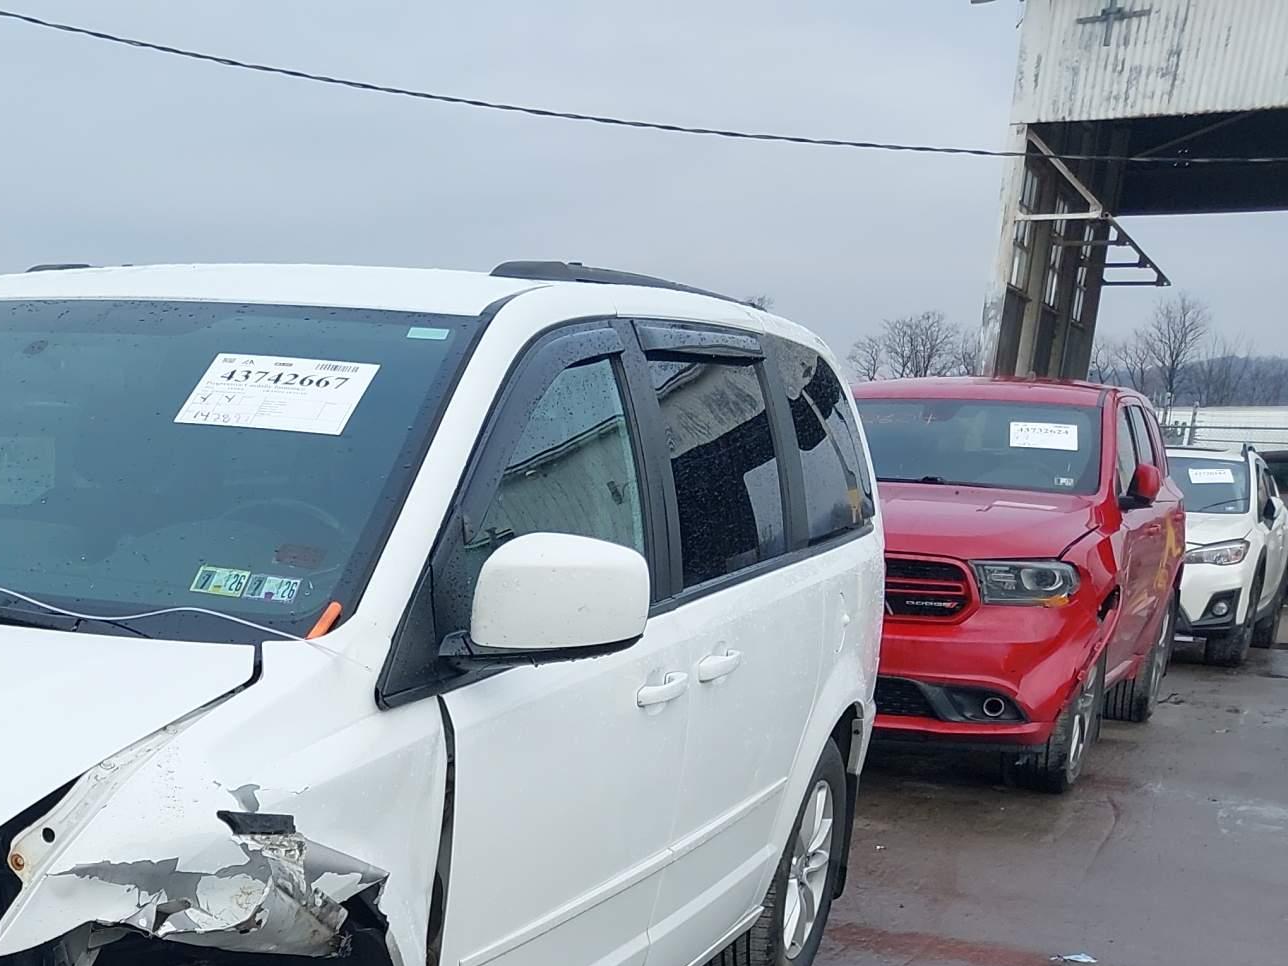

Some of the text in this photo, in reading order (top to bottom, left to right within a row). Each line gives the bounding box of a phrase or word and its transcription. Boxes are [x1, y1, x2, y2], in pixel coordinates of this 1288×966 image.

[220, 369, 350, 390] 43742667
[228, 573, 247, 592] 26
[280, 580, 298, 599] 26
